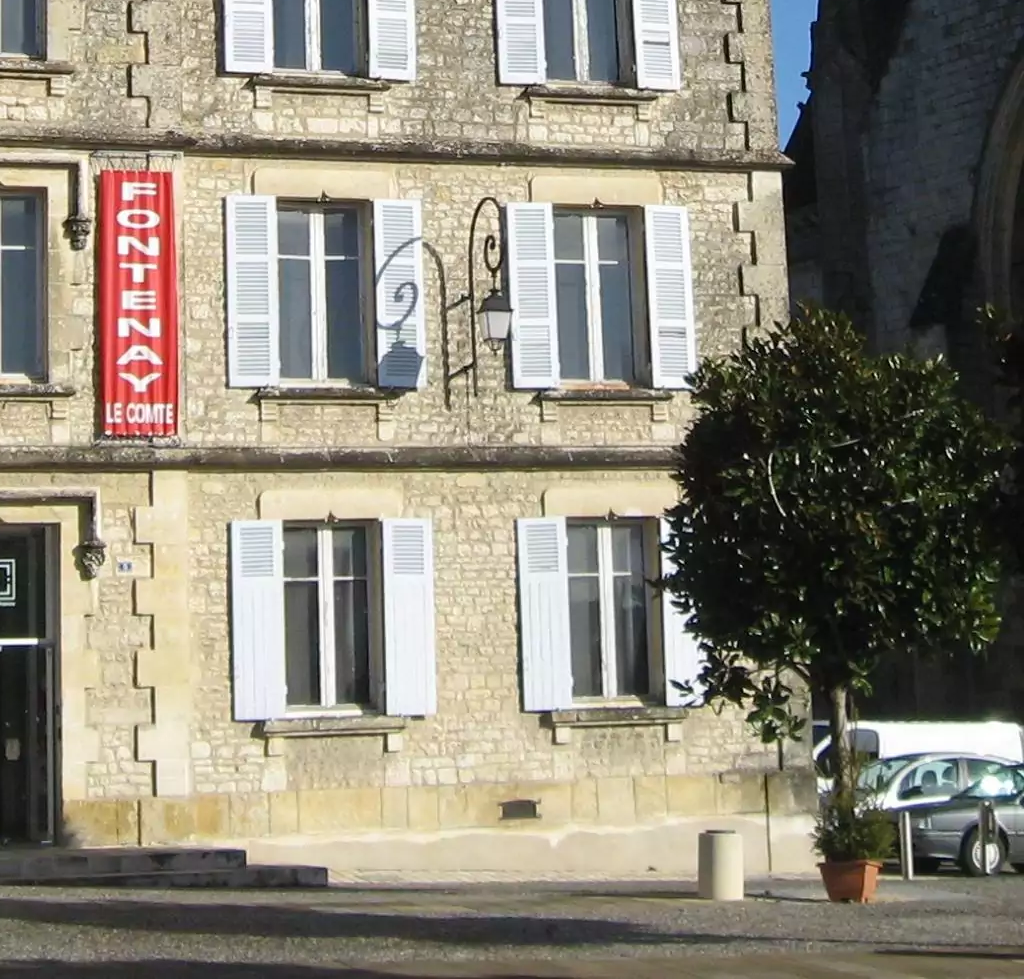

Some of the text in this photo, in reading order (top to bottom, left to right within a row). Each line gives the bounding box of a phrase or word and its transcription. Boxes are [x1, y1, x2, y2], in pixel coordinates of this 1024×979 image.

[116, 181, 164, 393] FONTENAY
[105, 402, 174, 424] LE COMTE
